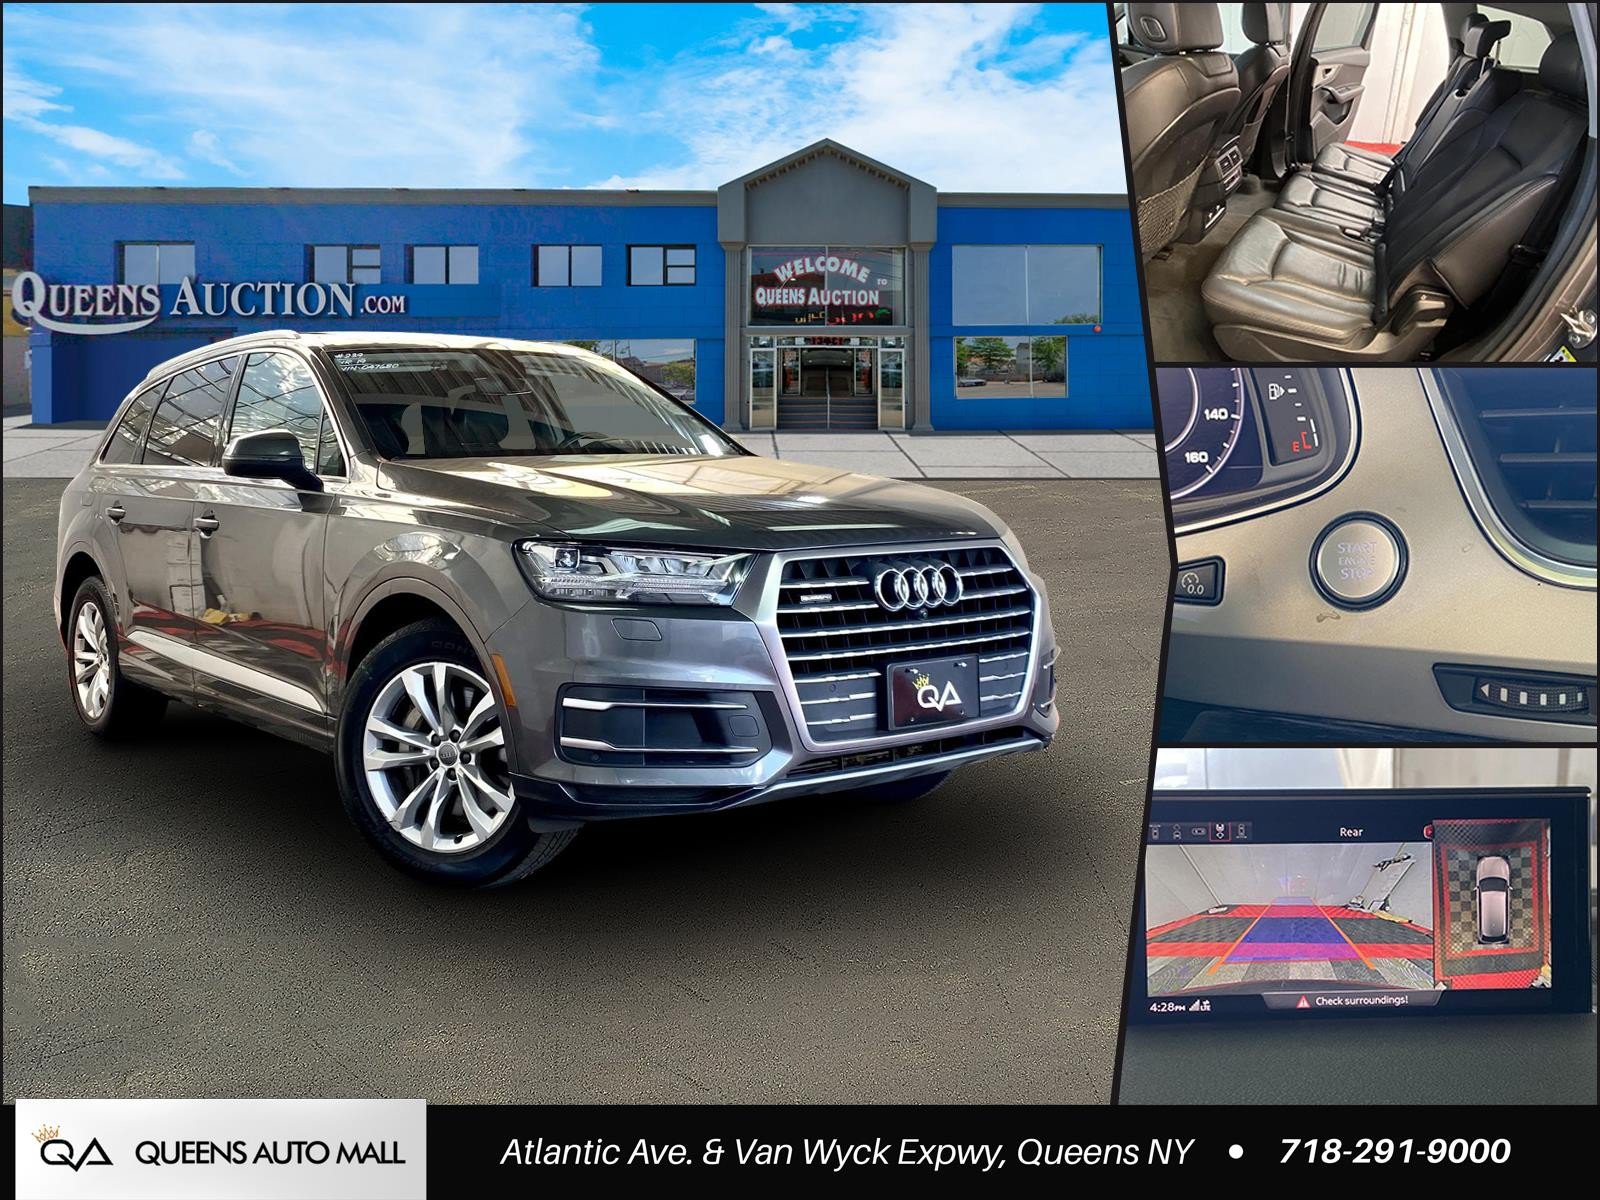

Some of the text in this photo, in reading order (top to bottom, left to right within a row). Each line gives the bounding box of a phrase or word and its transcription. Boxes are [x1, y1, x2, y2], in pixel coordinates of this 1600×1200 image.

[774, 255, 871, 284] WELCOME
[12, 271, 161, 335] QUEENS
[755, 286, 880, 307] QUEENS AUCTION
[1204, 408, 1229, 421] 140
[1184, 451, 1209, 464] 160
[1337, 542, 1377, 554] START
[1340, 567, 1375, 580] STOP
[1340, 827, 1363, 837] Rear
[1315, 995, 1409, 1007] Check surroundings!
